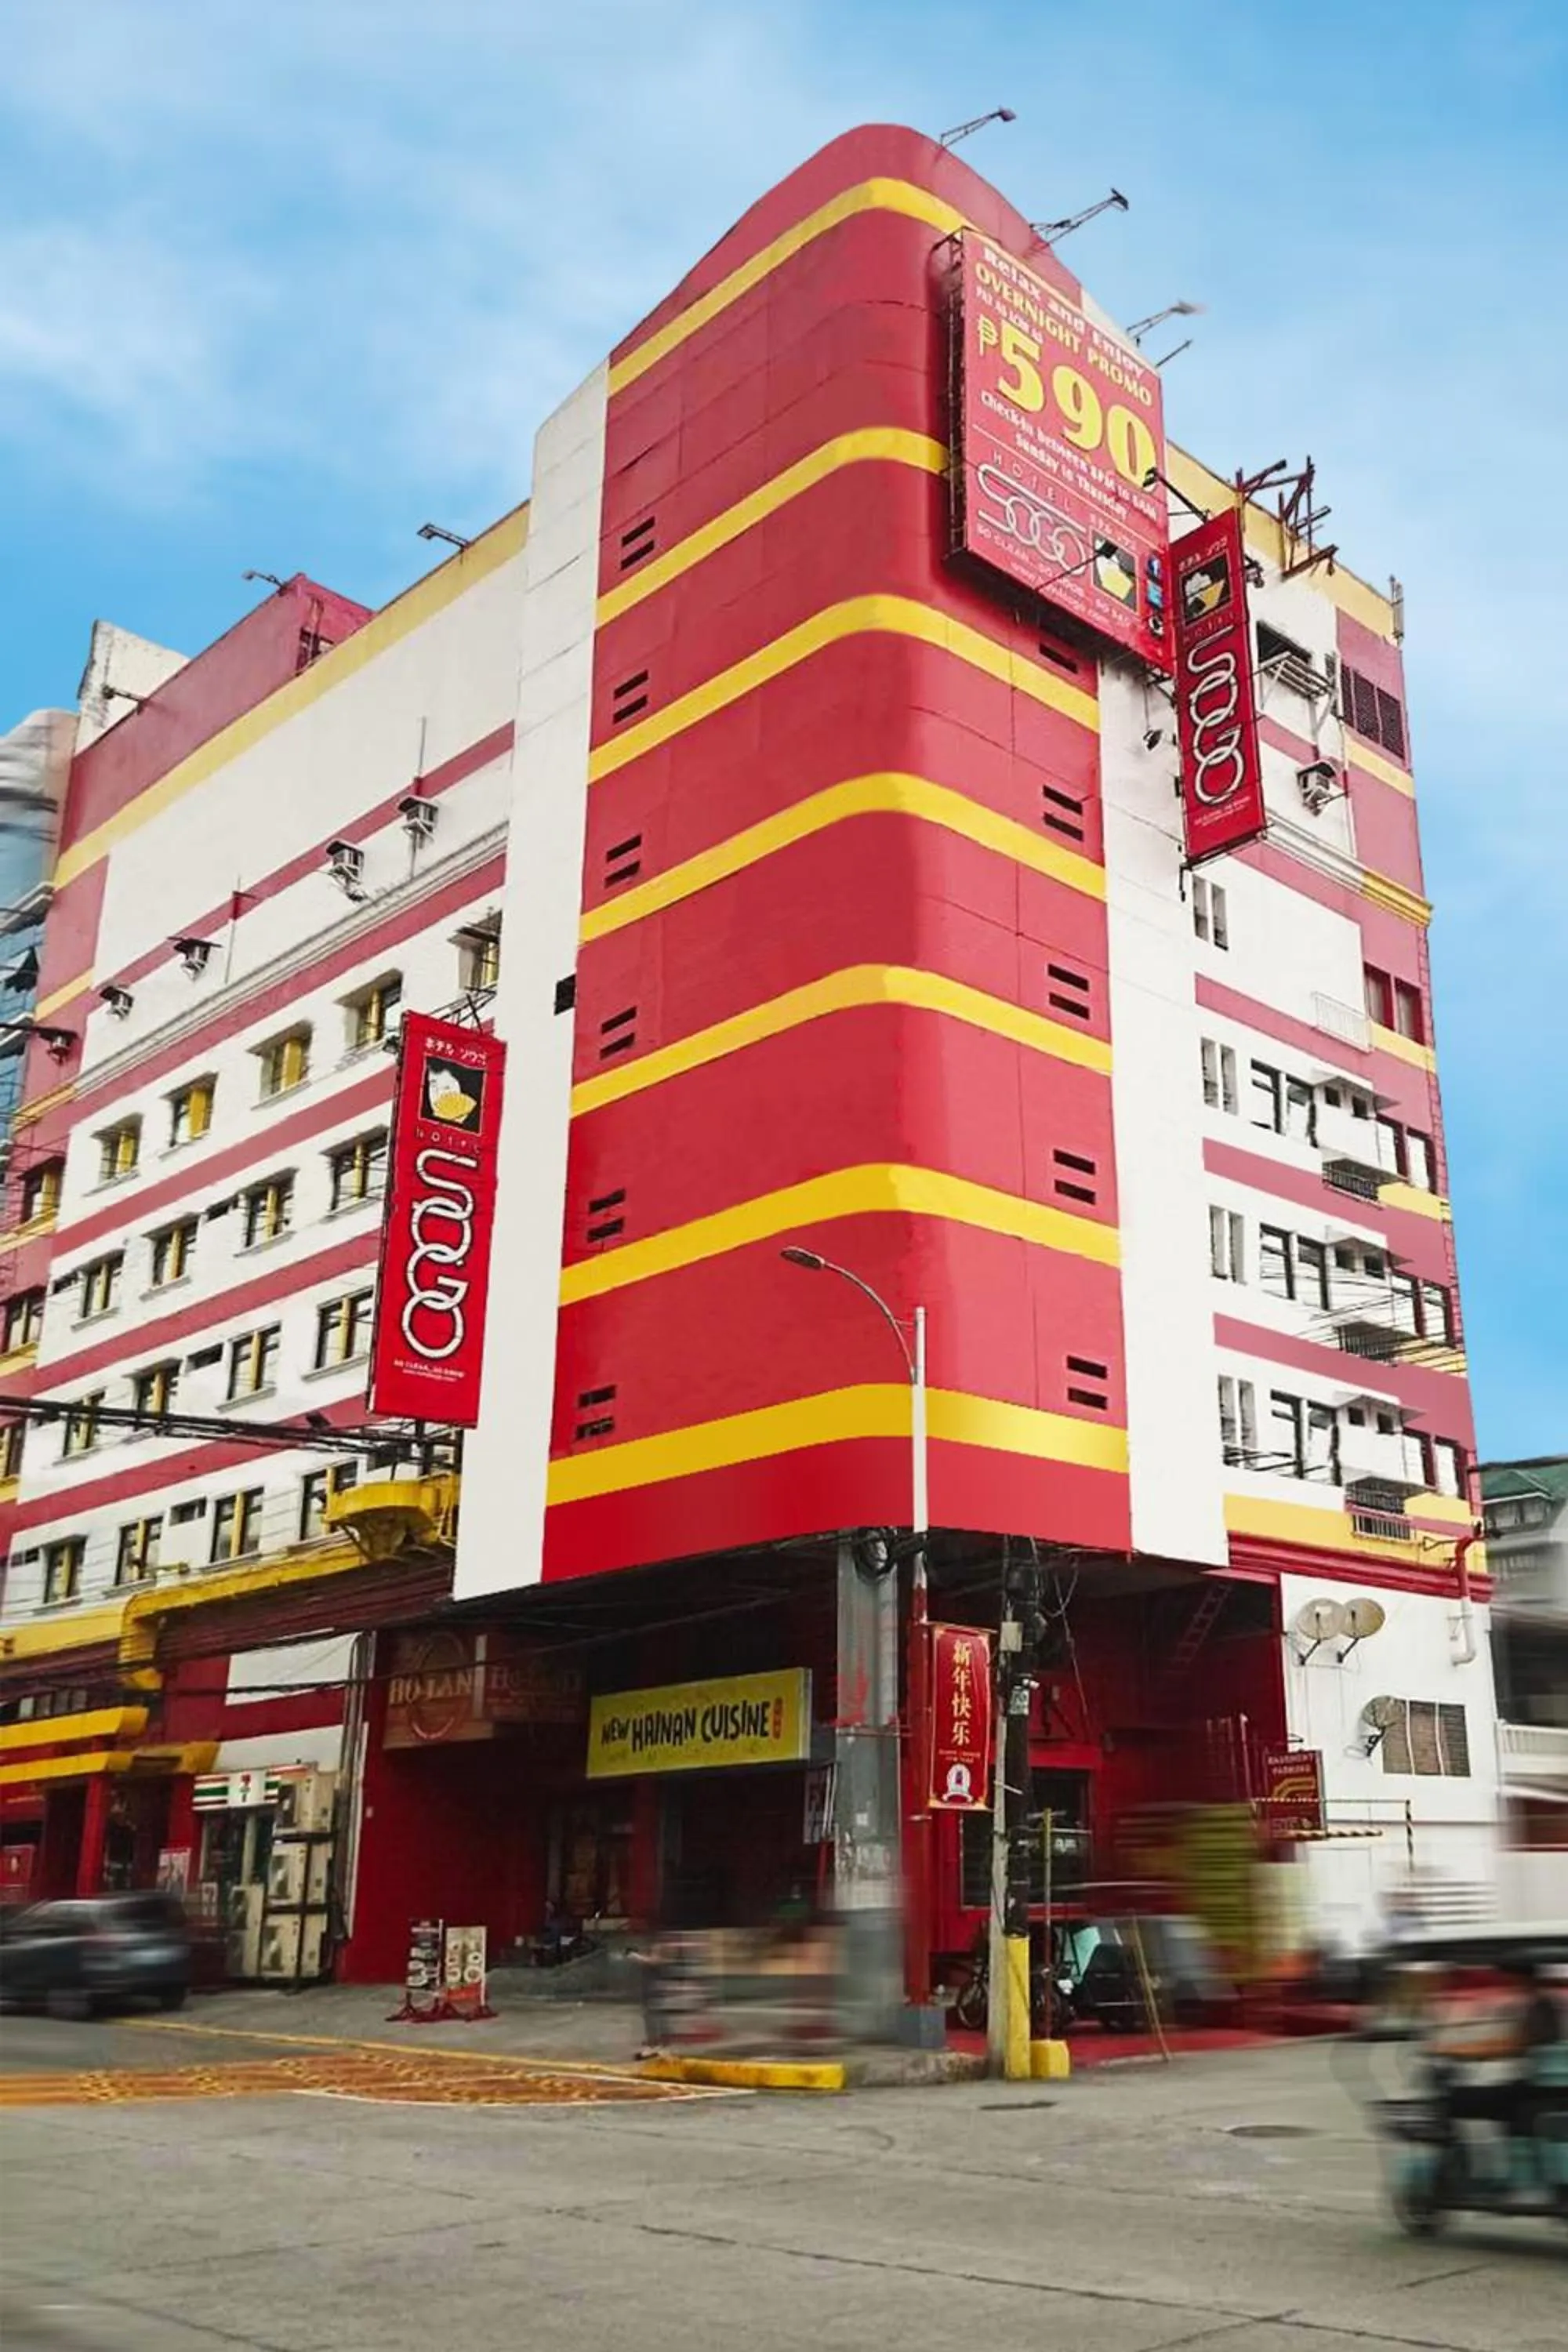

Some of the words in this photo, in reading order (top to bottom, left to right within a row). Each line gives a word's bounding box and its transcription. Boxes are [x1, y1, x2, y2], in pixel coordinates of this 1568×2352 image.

[975, 262, 1082, 354] OVERNIGHT
[1087, 347, 1152, 407] PROMO
[985, 246, 1042, 301] Relax
[1047, 299, 1086, 335] and
[1092, 329, 1145, 379] Enjoy
[401, 1148, 477, 1360] SOGO
[601, 1716, 630, 1746] NEW
[632, 1706, 697, 1753] HAINAN
[701, 1699, 771, 1744] CUISINE
[951, 1639, 973, 1747] 新年快乐
